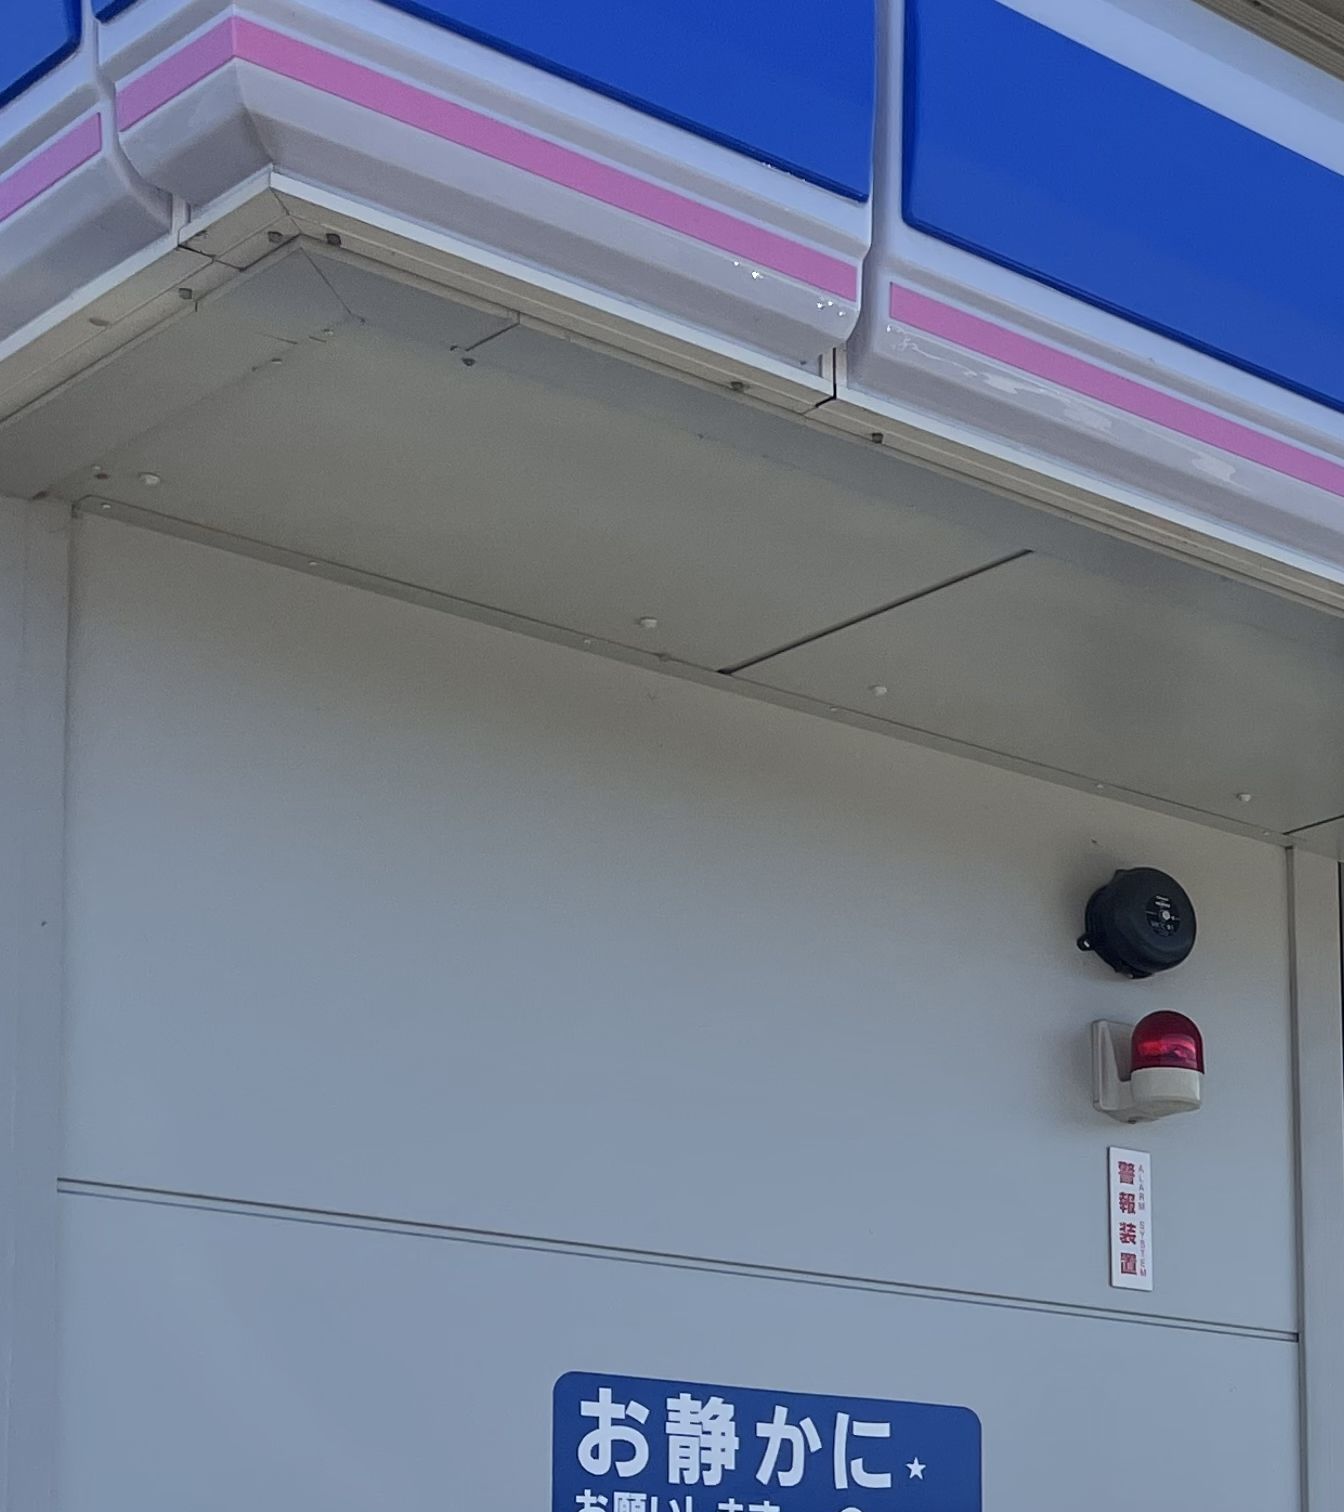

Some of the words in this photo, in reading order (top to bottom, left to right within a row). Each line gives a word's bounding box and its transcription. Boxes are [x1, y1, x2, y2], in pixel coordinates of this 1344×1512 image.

[1118, 1161, 1137, 1275] 警報装置
[576, 1387, 892, 1489] お静かに
